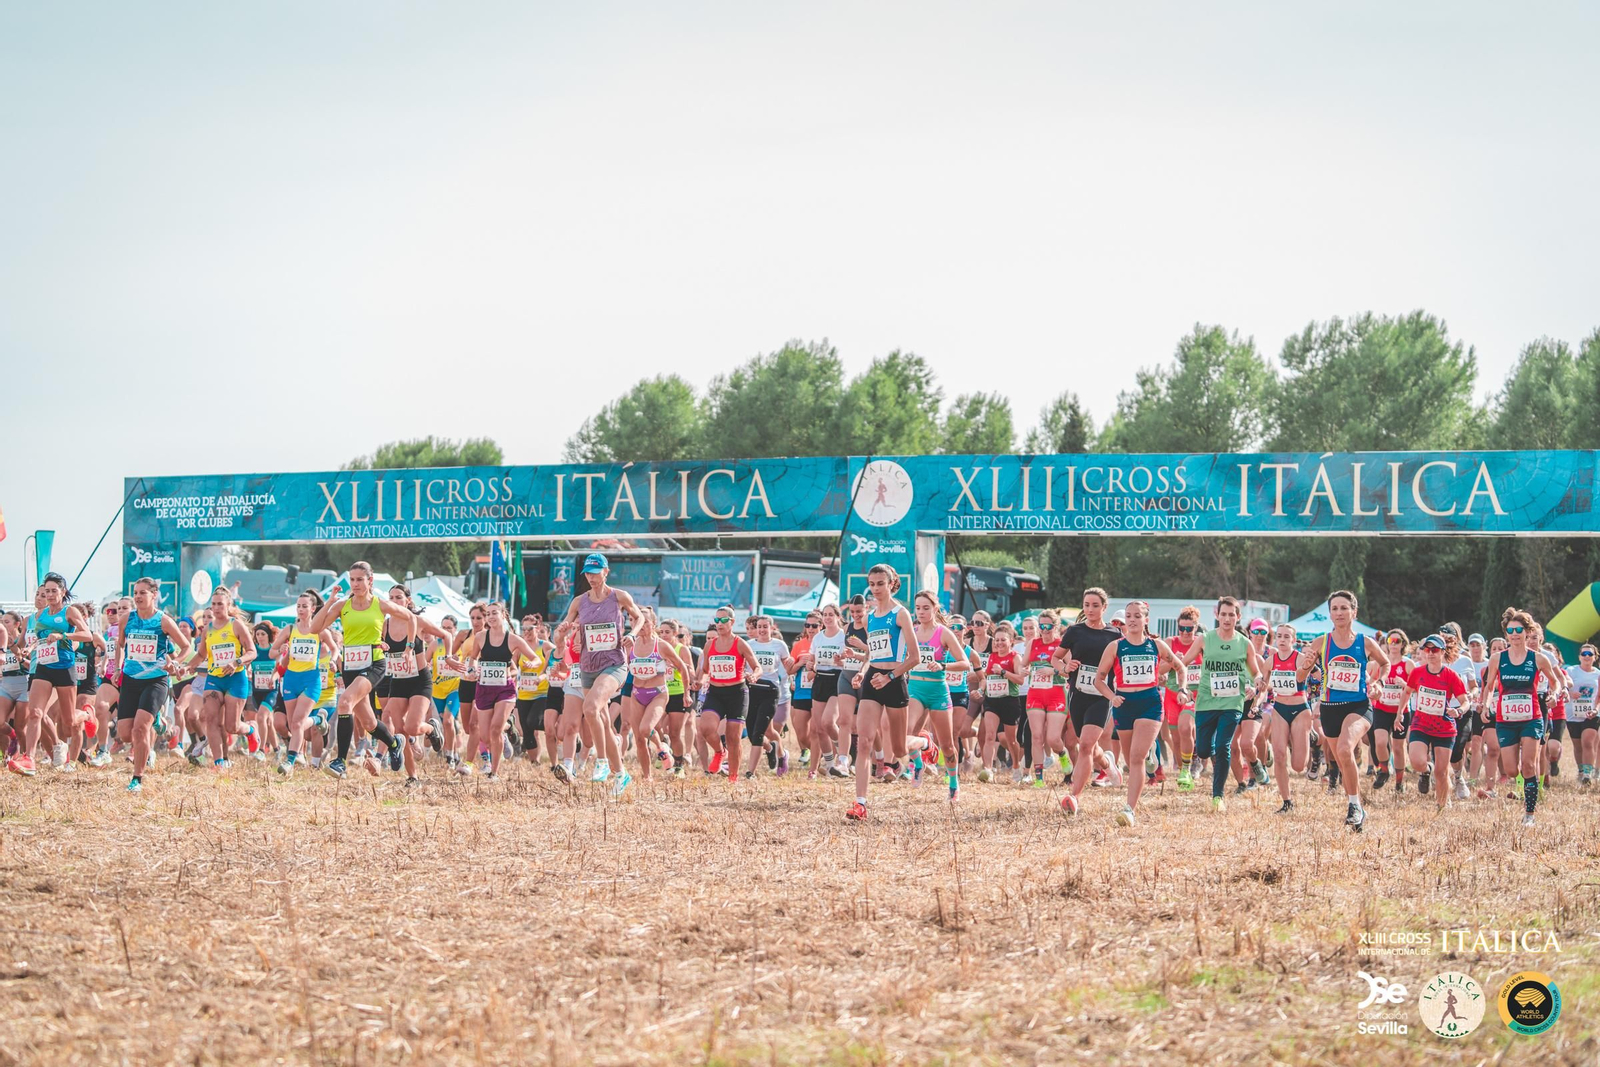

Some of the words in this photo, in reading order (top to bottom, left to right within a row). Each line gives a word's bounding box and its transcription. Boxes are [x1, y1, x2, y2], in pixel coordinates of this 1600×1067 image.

[1082, 466, 1187, 494] CROSS
[1237, 452, 1508, 516] ITÁLICA
[426, 476, 512, 504] CROSS
[554, 462, 778, 522] ITÁLICA
[948, 466, 1078, 512] XLIII
[134, 496, 201, 509] CAMPEONATO
[203, 496, 214, 506] DE
[216, 492, 276, 506] ANDALUCÍA
[316, 480, 423, 522] XLIII
[1082, 497, 1226, 511] INTERNACIONAL
[156, 508, 170, 518] DE
[170, 506, 205, 518] CAMPO
[207, 507, 214, 516] A
[216, 504, 254, 516] TRAVÉS
[426, 504, 545, 519] INTERNACIONAL
[177, 518, 194, 528] POR
[196, 516, 232, 528] CLUBES
[948, 516, 1070, 529] INTERNATIONAL
[1074, 516, 1121, 529] CROSS
[1124, 516, 1199, 530] COUNTRY
[316, 526, 417, 538] INTERNATIONAL
[420, 524, 458, 536] CROSS
[461, 522, 522, 536] COUNTRY
[880, 545, 906, 553] Sevilla
[590, 633, 616, 644] 1425
[130, 644, 155, 654] 1412
[869, 639, 888, 651] 1317
[38, 647, 56, 658] 1282
[215, 651, 234, 660] 1427
[346, 651, 369, 662] 1217
[483, 670, 504, 678] 1502
[633, 667, 655, 675] 1423
[712, 664, 734, 673] 1168
[1126, 665, 1153, 675] 1314
[946, 673, 962, 681] 254
[1080, 675, 1095, 685] 11
[1331, 671, 1358, 683] 1487
[988, 683, 1007, 691] 1257
[1214, 680, 1238, 690] 1146
[1272, 680, 1295, 688] 1146
[1420, 696, 1443, 708] 1375
[1505, 704, 1530, 714] 1460
